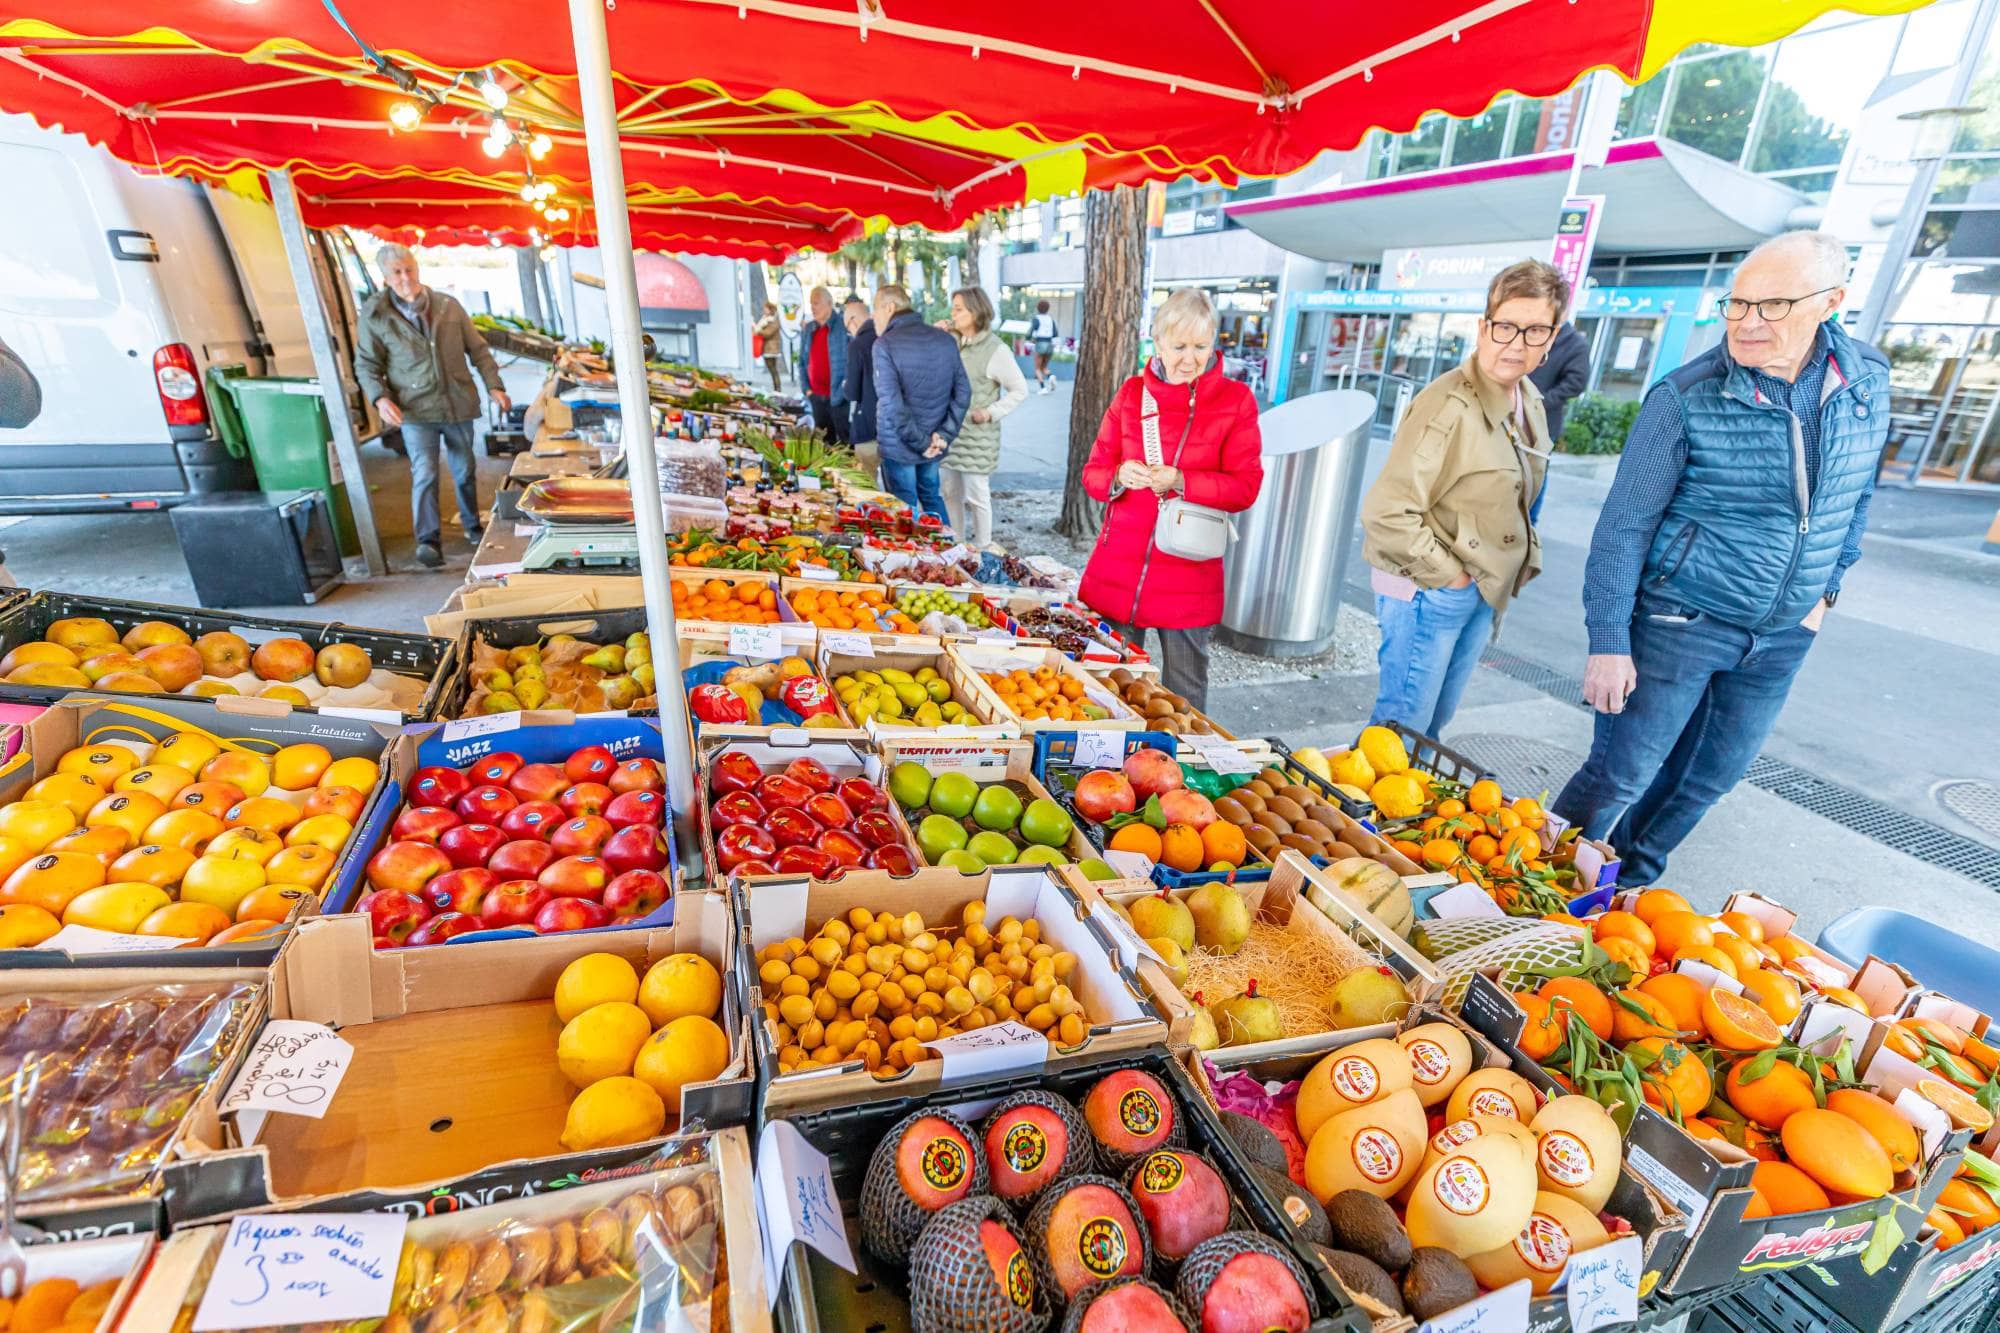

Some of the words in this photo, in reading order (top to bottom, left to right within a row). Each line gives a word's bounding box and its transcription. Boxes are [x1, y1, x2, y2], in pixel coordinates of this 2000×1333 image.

[1426, 256, 1485, 275] FORUM
[1353, 292, 1394, 305] WELCOME
[309, 723, 363, 738] Tentation
[446, 740, 492, 762] JAZZ
[603, 735, 642, 755] JAZZ
[581, 1160, 650, 1182] Giovanni
[1741, 1220, 1874, 1265] Pelligra
